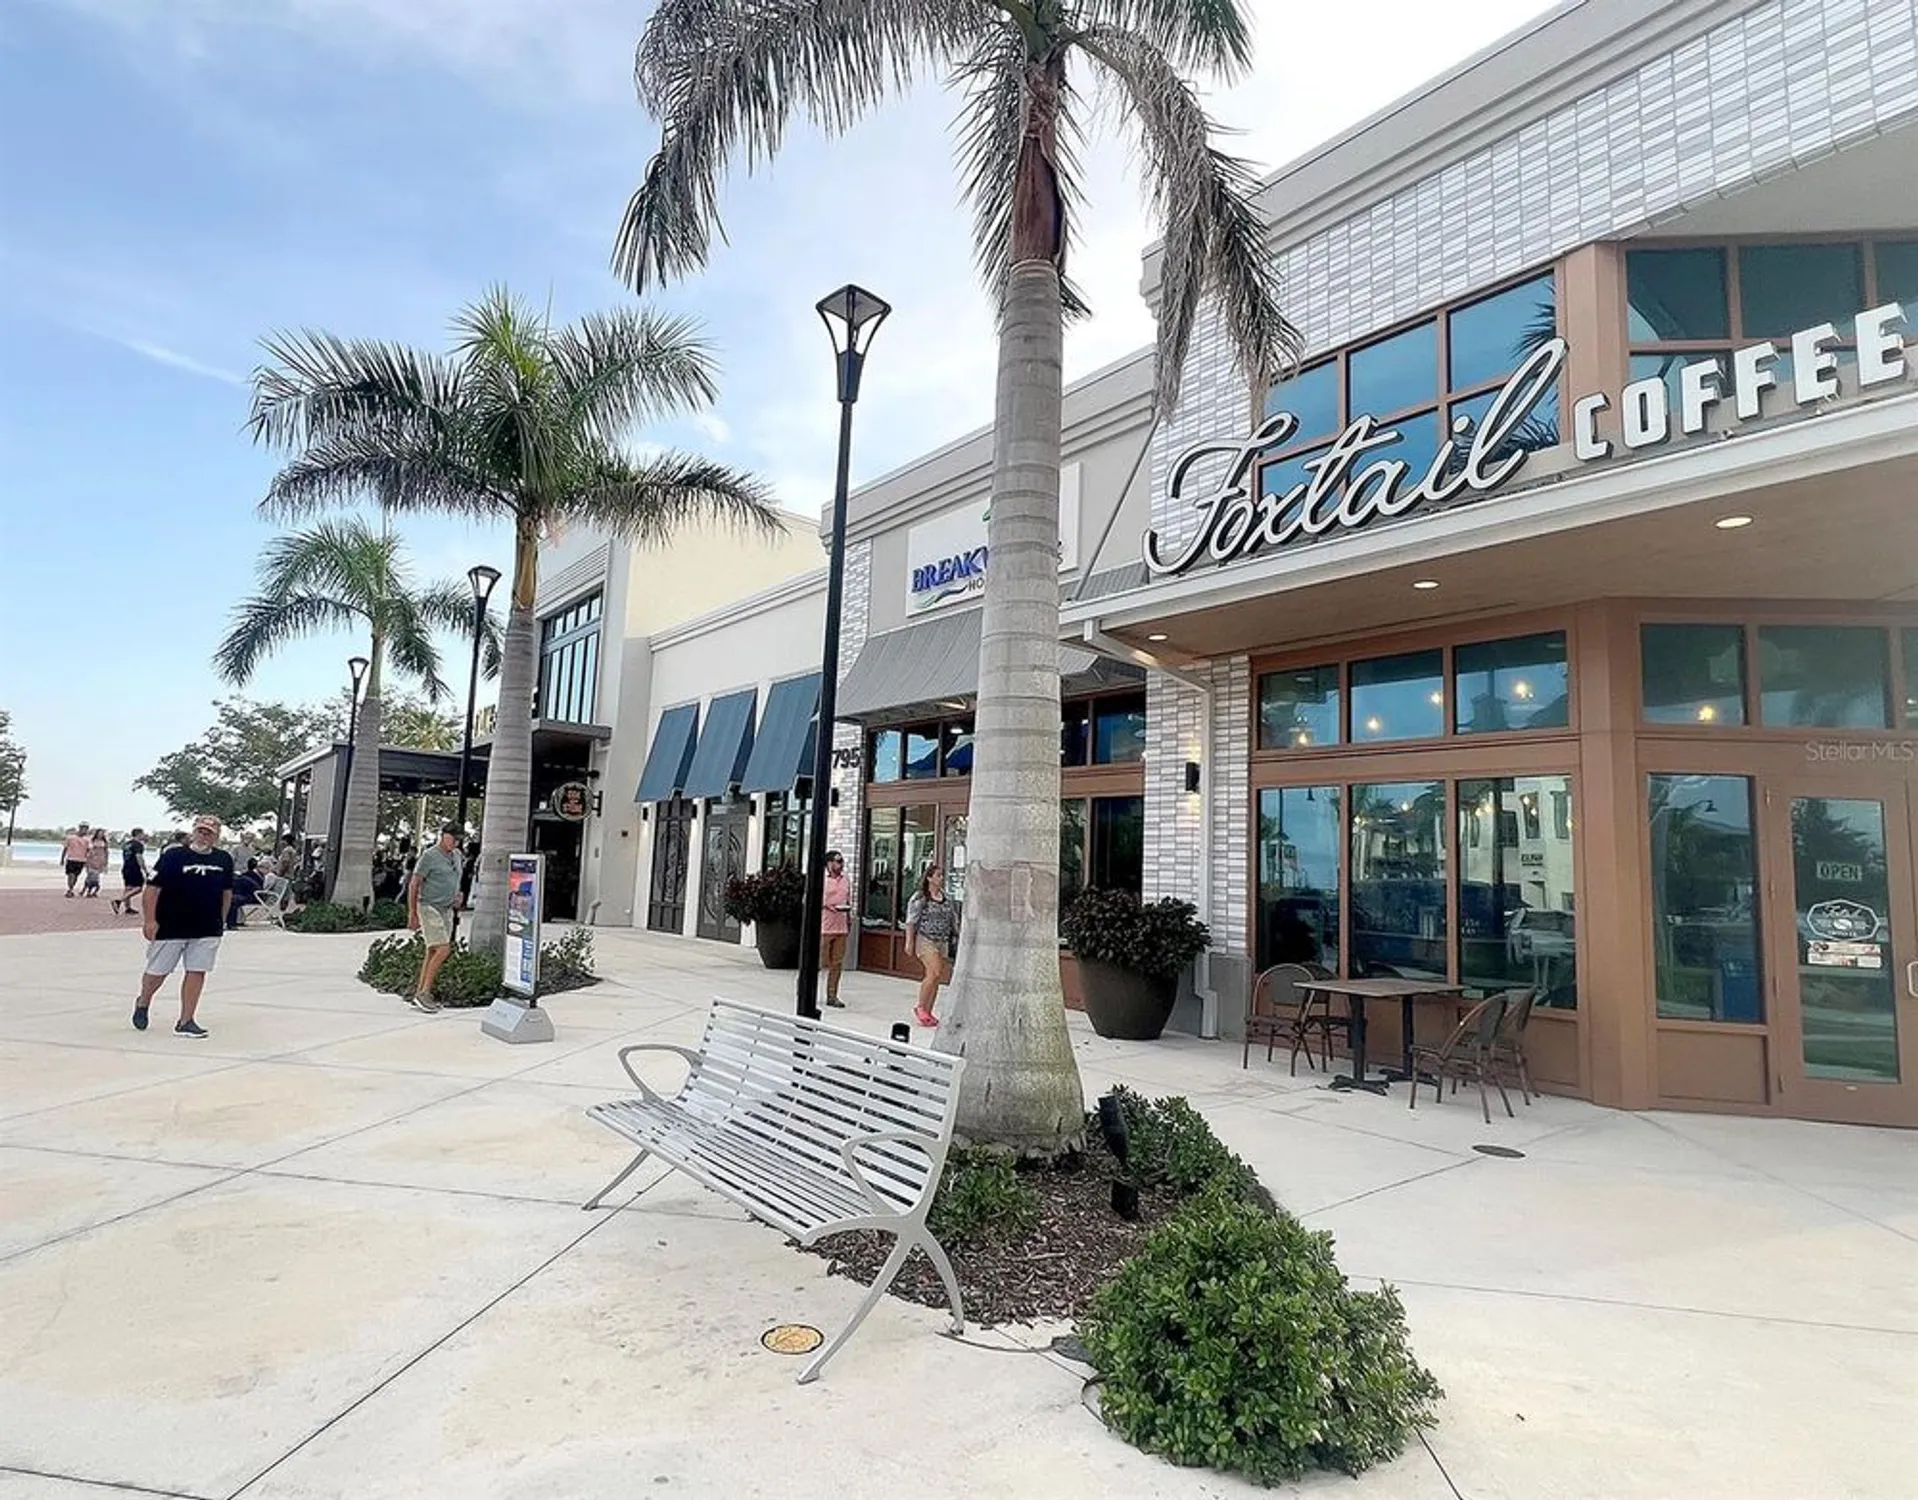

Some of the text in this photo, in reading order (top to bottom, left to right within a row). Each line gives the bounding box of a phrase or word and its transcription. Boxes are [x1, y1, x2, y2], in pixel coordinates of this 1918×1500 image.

[1142, 302, 1907, 573] Foxtail COFFEE
[830, 747, 861, 769] 795
[1819, 863, 1859, 880] OPEN
